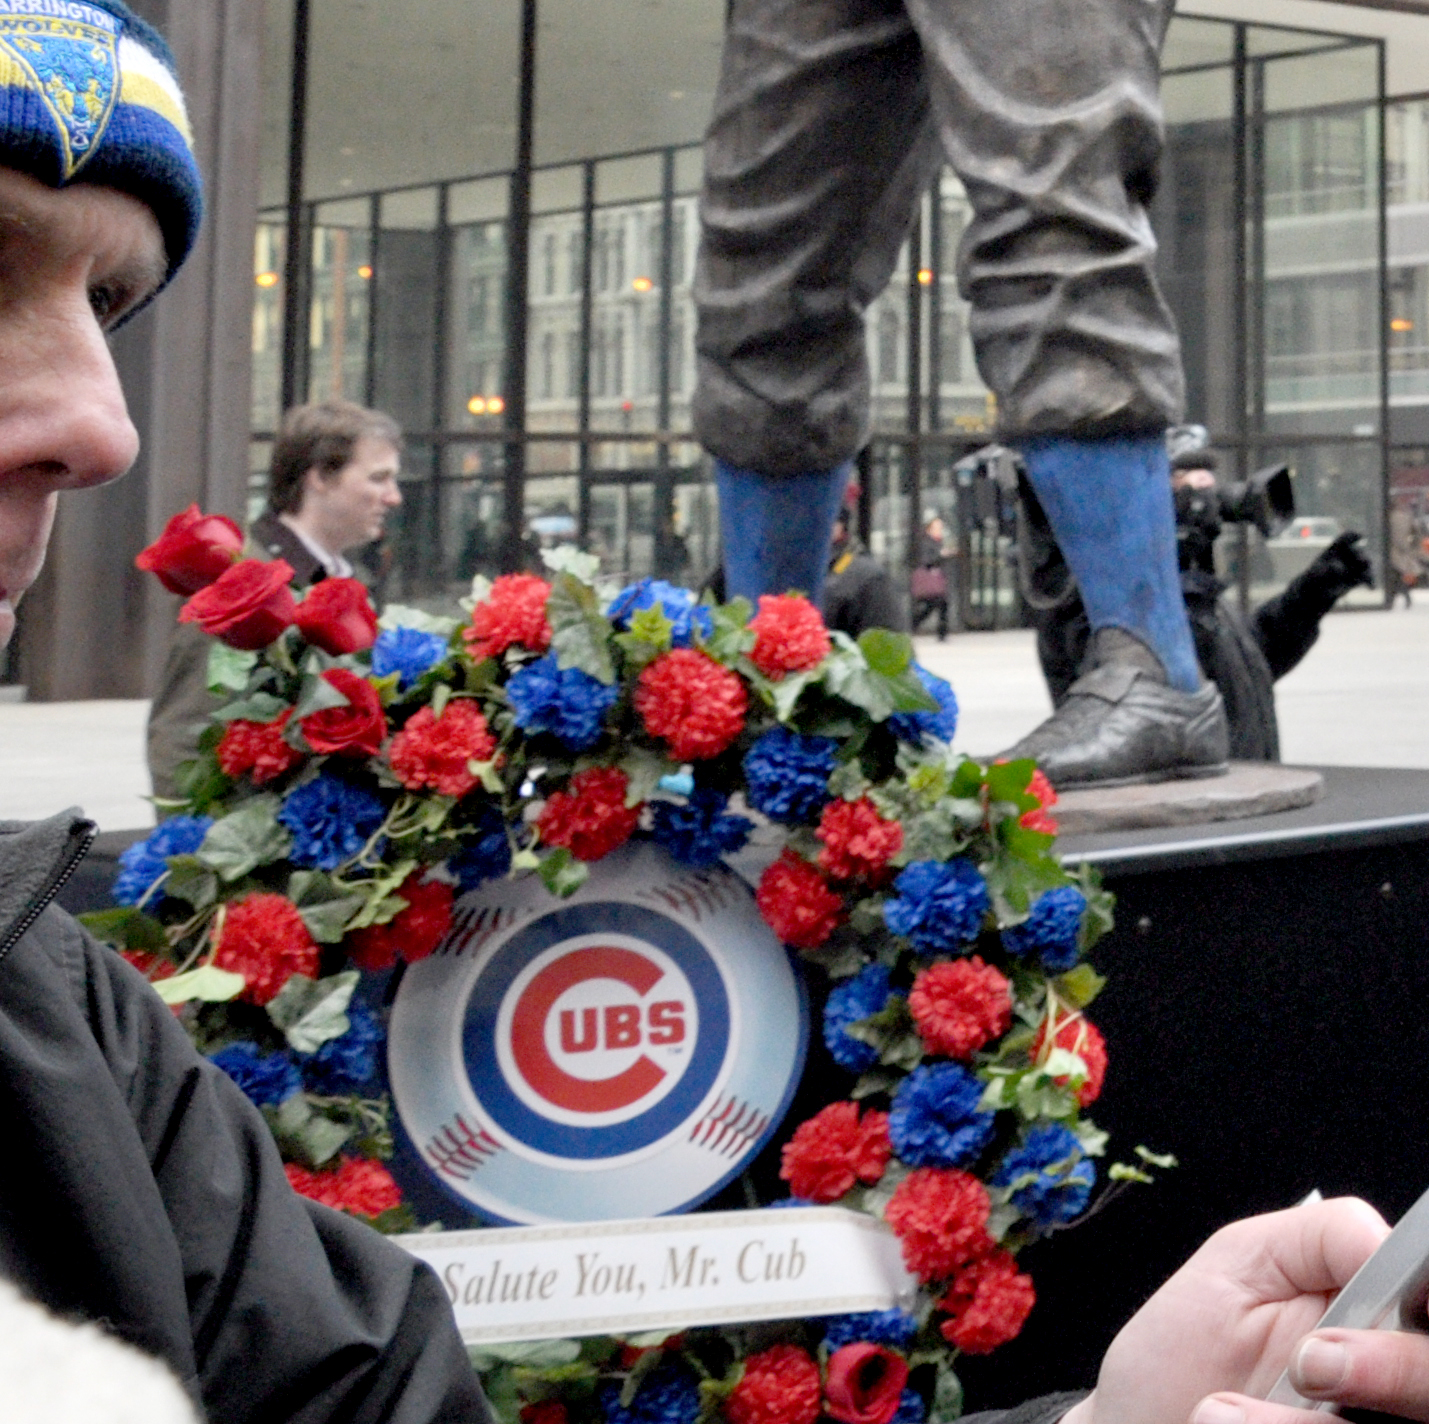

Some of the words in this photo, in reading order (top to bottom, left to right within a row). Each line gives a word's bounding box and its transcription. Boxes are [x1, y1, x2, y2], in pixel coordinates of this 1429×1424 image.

[444, 1260, 558, 1306] Salute
[574, 1252, 647, 1301] You,
[660, 1244, 720, 1290] Mr.
[736, 1237, 807, 1285] Cub
